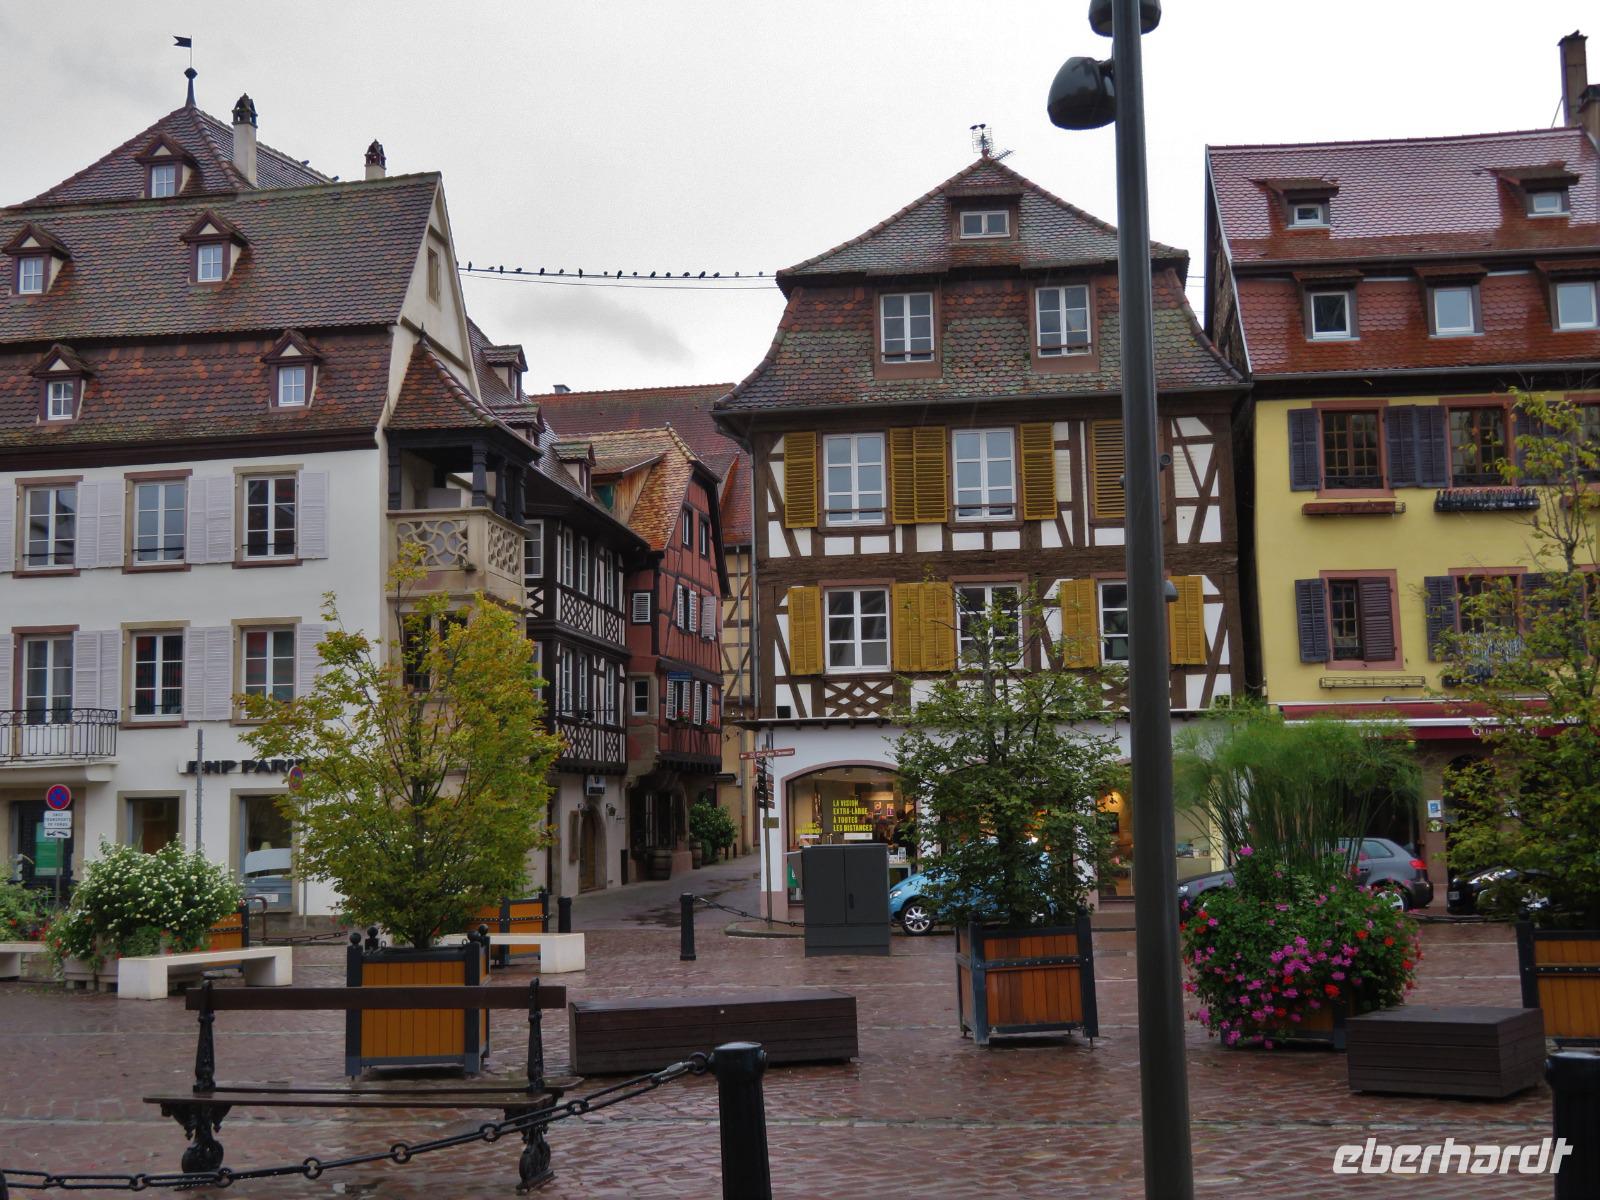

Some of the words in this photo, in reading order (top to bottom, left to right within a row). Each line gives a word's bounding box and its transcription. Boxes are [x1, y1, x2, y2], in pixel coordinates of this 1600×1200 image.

[832, 799, 840, 807] LA
[840, 799, 859, 807] VISION
[838, 816, 858, 824] TOUTES
[833, 824, 843, 832] LES
[843, 824, 873, 832] DISTANCES
